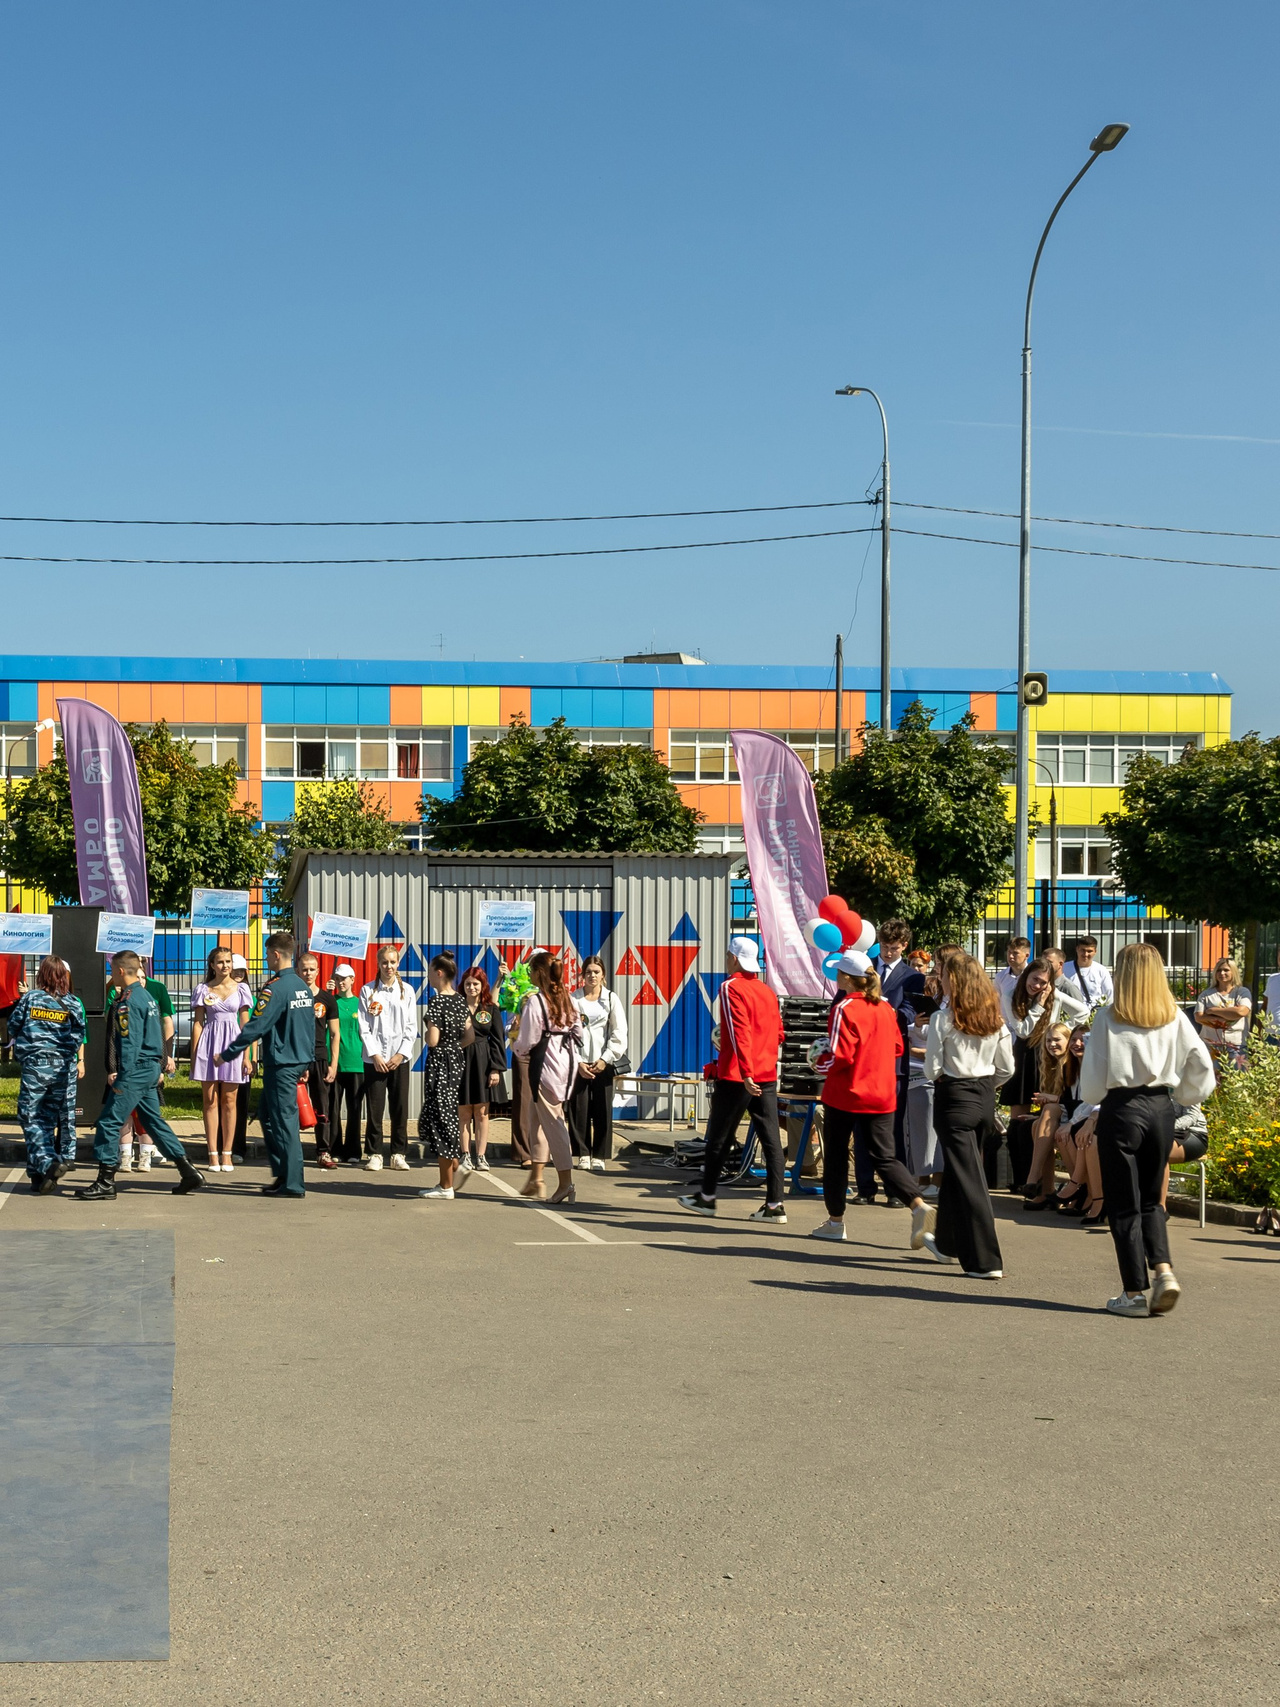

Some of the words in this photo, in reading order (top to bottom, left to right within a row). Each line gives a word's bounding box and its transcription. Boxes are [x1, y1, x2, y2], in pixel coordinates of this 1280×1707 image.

[194, 912, 222, 920] индустрии
[2, 930, 45, 938] Кинология
[107, 929, 145, 939] Дошкольное
[320, 930, 360, 942] Физическая
[106, 936, 145, 945] образование
[324, 938, 354, 948] культура
[294, 990, 308, 999] МЧС
[289, 998, 313, 1009] РОССИИ
[32, 1009, 66, 1021] КИНОЛО
